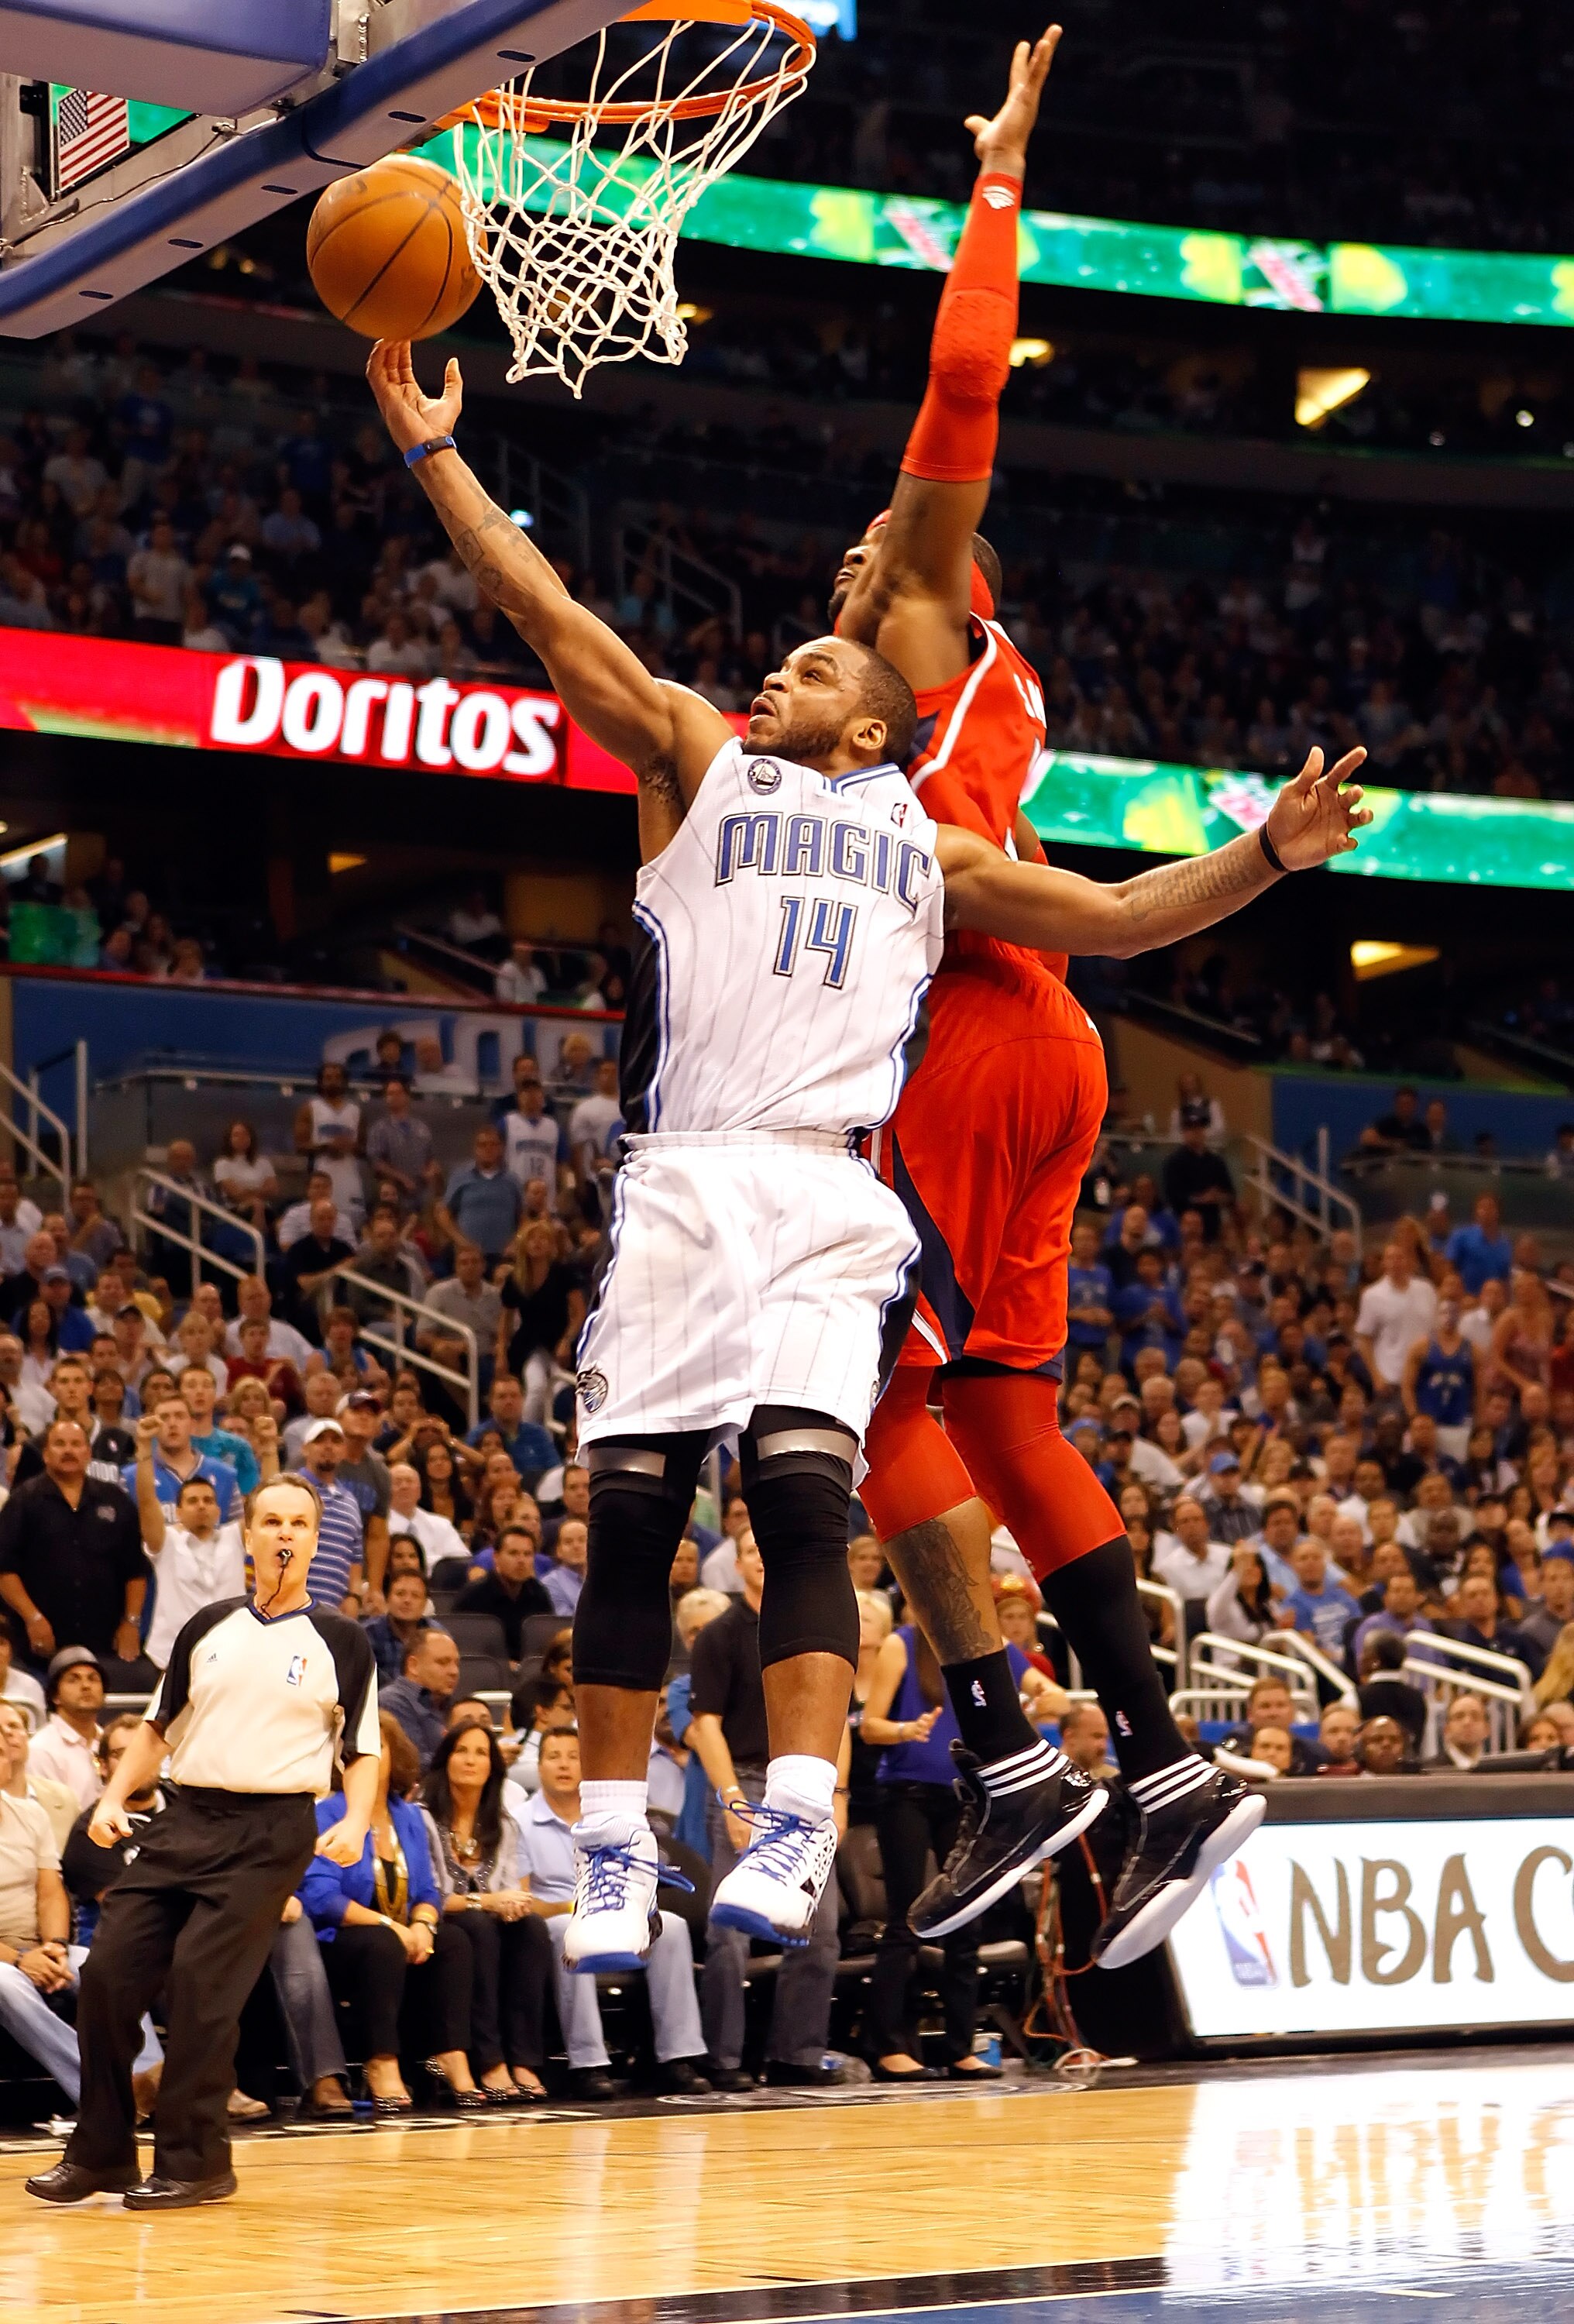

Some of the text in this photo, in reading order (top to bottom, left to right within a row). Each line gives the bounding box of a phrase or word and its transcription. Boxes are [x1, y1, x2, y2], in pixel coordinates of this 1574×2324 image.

[211, 655, 560, 776] Doritos
[715, 811, 933, 918] MAGIC
[773, 896, 858, 990] 14
[1288, 1845, 1574, 1988] NBA C
